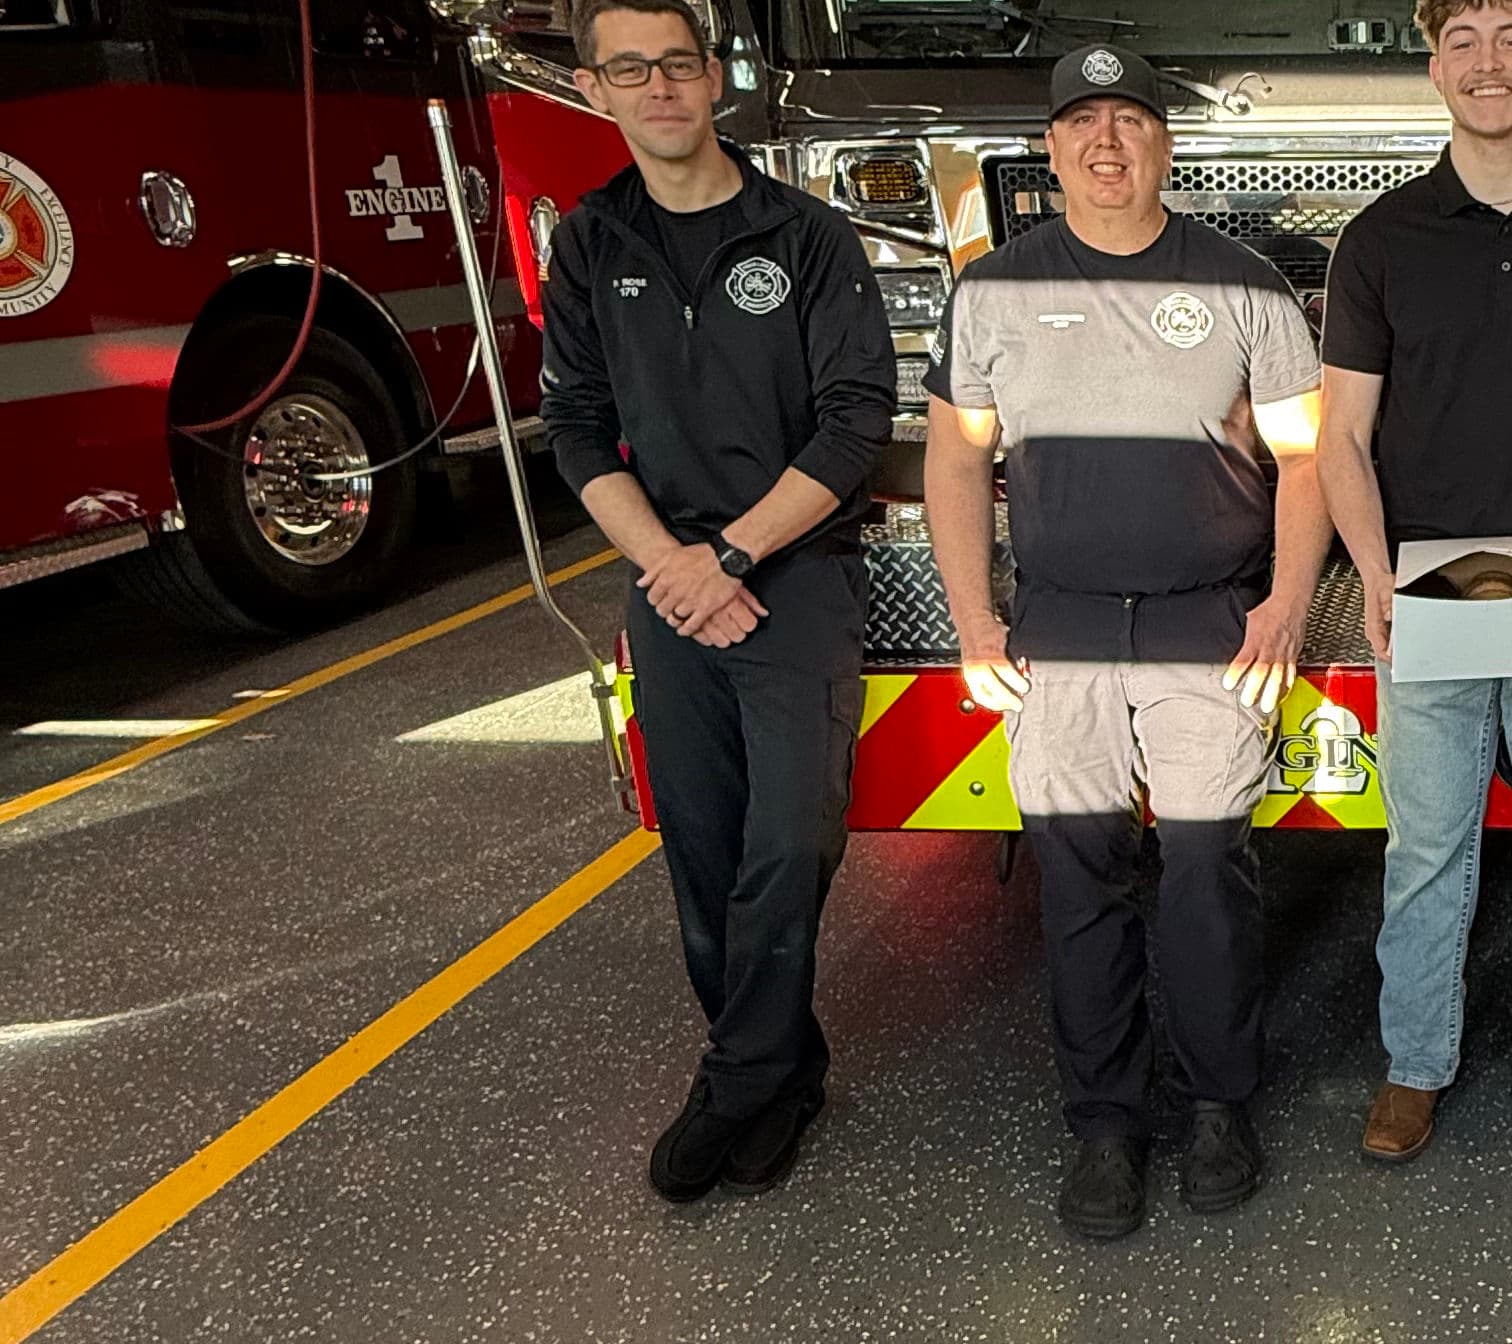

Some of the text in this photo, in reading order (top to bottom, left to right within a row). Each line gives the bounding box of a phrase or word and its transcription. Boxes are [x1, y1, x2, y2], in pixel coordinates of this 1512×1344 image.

[345, 186, 446, 216] ENGINE
[372, 155, 424, 241] 1
[40, 187, 72, 268] EXCELLENCE
[0, 283, 57, 316] MUNITY
[619, 287, 639, 297] 170
[1275, 735, 1378, 772] GIN
